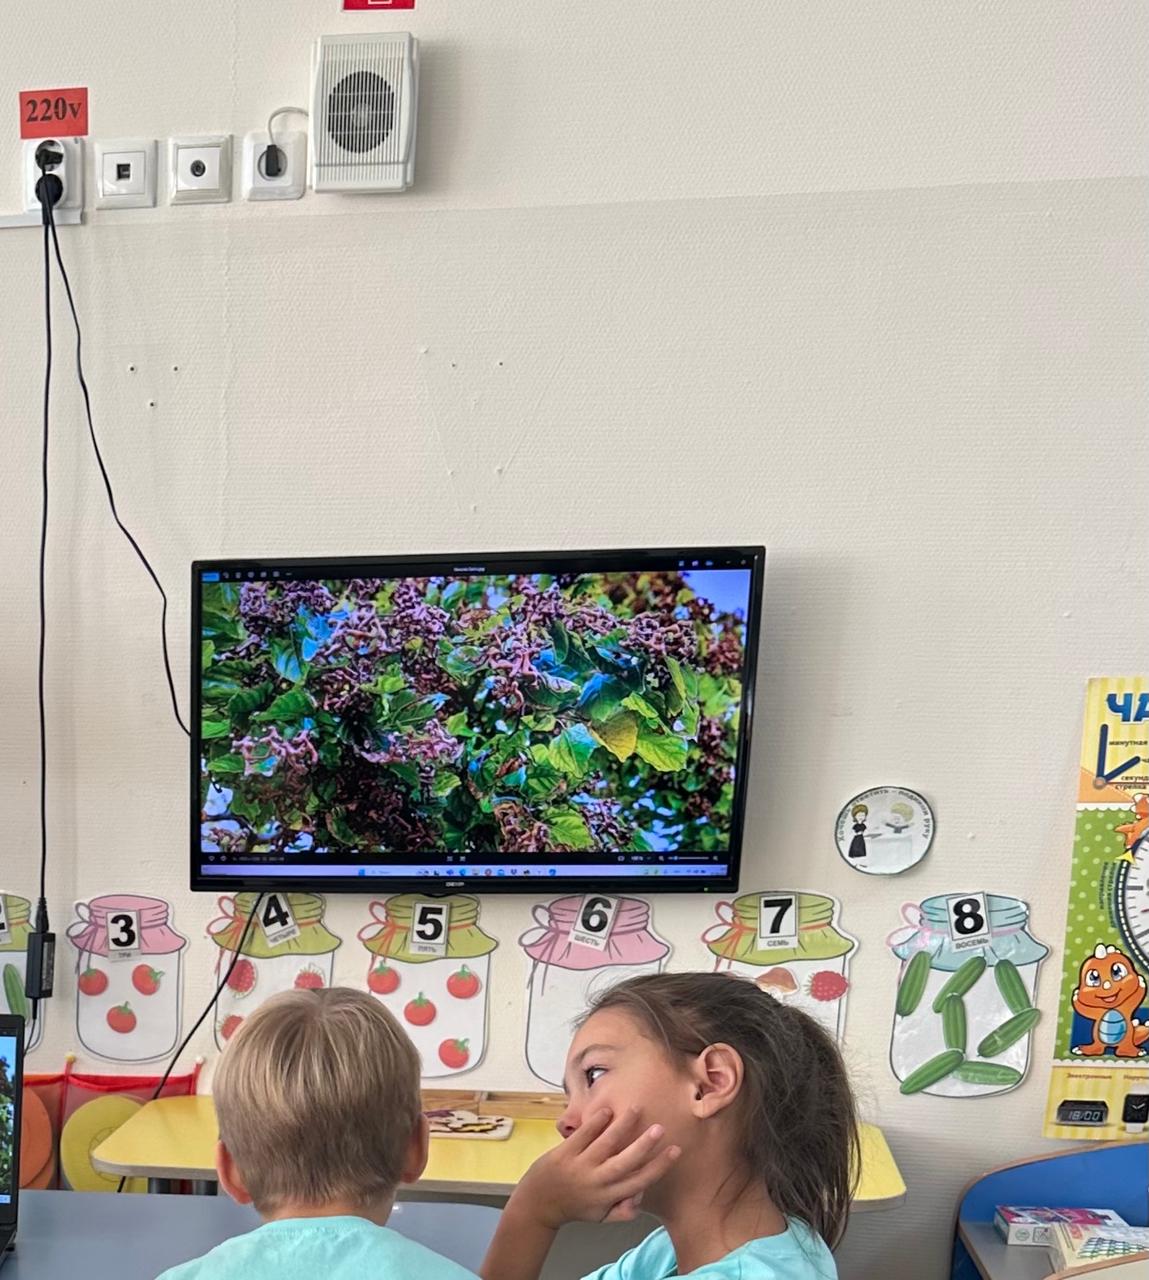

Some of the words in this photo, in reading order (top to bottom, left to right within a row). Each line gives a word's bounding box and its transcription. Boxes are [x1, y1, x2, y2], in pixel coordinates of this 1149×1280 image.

[26, 97, 82, 122] 220v
[898, 790, 929, 815] подними
[922, 818, 931, 839] руку
[262, 894, 290, 928] 4
[416, 907, 443, 941] 5
[581, 897, 612, 932] 6
[763, 898, 792, 934] 7
[953, 898, 984, 935] 8
[110, 914, 136, 947] 3
[574, 934, 600, 947] ШЕСТЬ
[955, 938, 989, 950] ВОСЕМЬ
